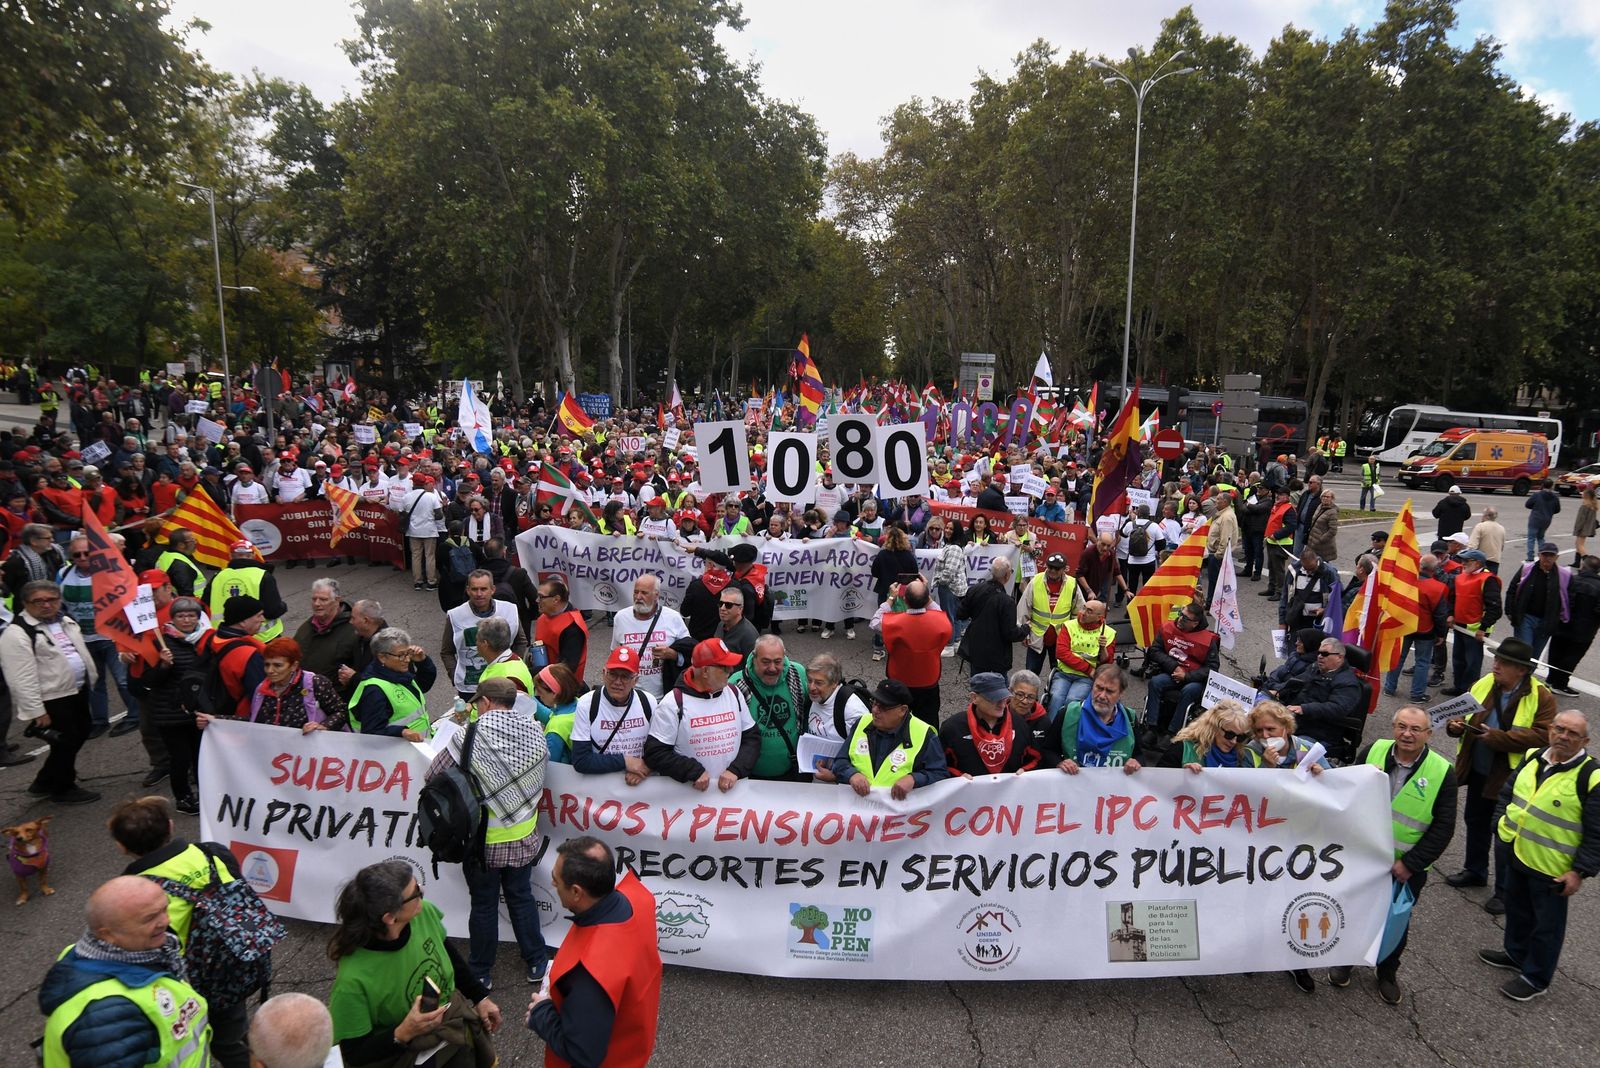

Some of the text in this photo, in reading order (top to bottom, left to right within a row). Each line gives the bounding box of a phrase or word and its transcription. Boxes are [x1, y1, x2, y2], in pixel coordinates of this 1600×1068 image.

[620, 437, 640, 451] NO
[835, 419, 874, 479] 8
[708, 427, 740, 487] 1
[884, 430, 922, 491] 0
[772, 437, 810, 497] 0
[307, 520, 326, 528] SIN
[286, 534, 309, 543] CON
[534, 535, 558, 551] NO
[561, 541, 569, 554] A
[572, 541, 591, 562] LA
[597, 545, 666, 566] BRECHA
[667, 555, 686, 569] DE
[762, 550, 784, 567] EN
[789, 549, 878, 568] SALARIOS
[542, 557, 567, 572] LAS
[668, 574, 686, 589] DE
[768, 570, 825, 588] IENEN
[829, 571, 875, 591] ROST
[1208, 677, 1220, 690] Como
[1227, 688, 1240, 699] mayor
[1429, 699, 1467, 716] nsiones
[691, 712, 734, 727] ASJUBI40
[703, 732, 739, 743] PENALIZAR
[695, 746, 735, 758] COTIZADOS
[270, 752, 1288, 846] SUBIDA ARIOS Y PENSIONES CON EL IPC REAL
[217, 793, 256, 832] NI
[262, 798, 424, 849] PRIVATI
[615, 845, 825, 889] RECORTES
[838, 858, 888, 890] EN
[901, 847, 1119, 897] SERVICIOS
[1131, 839, 1346, 890] PÚBLICOS
[843, 907, 872, 922] MO
[832, 921, 857, 936] DE
[830, 936, 871, 952] PEN
